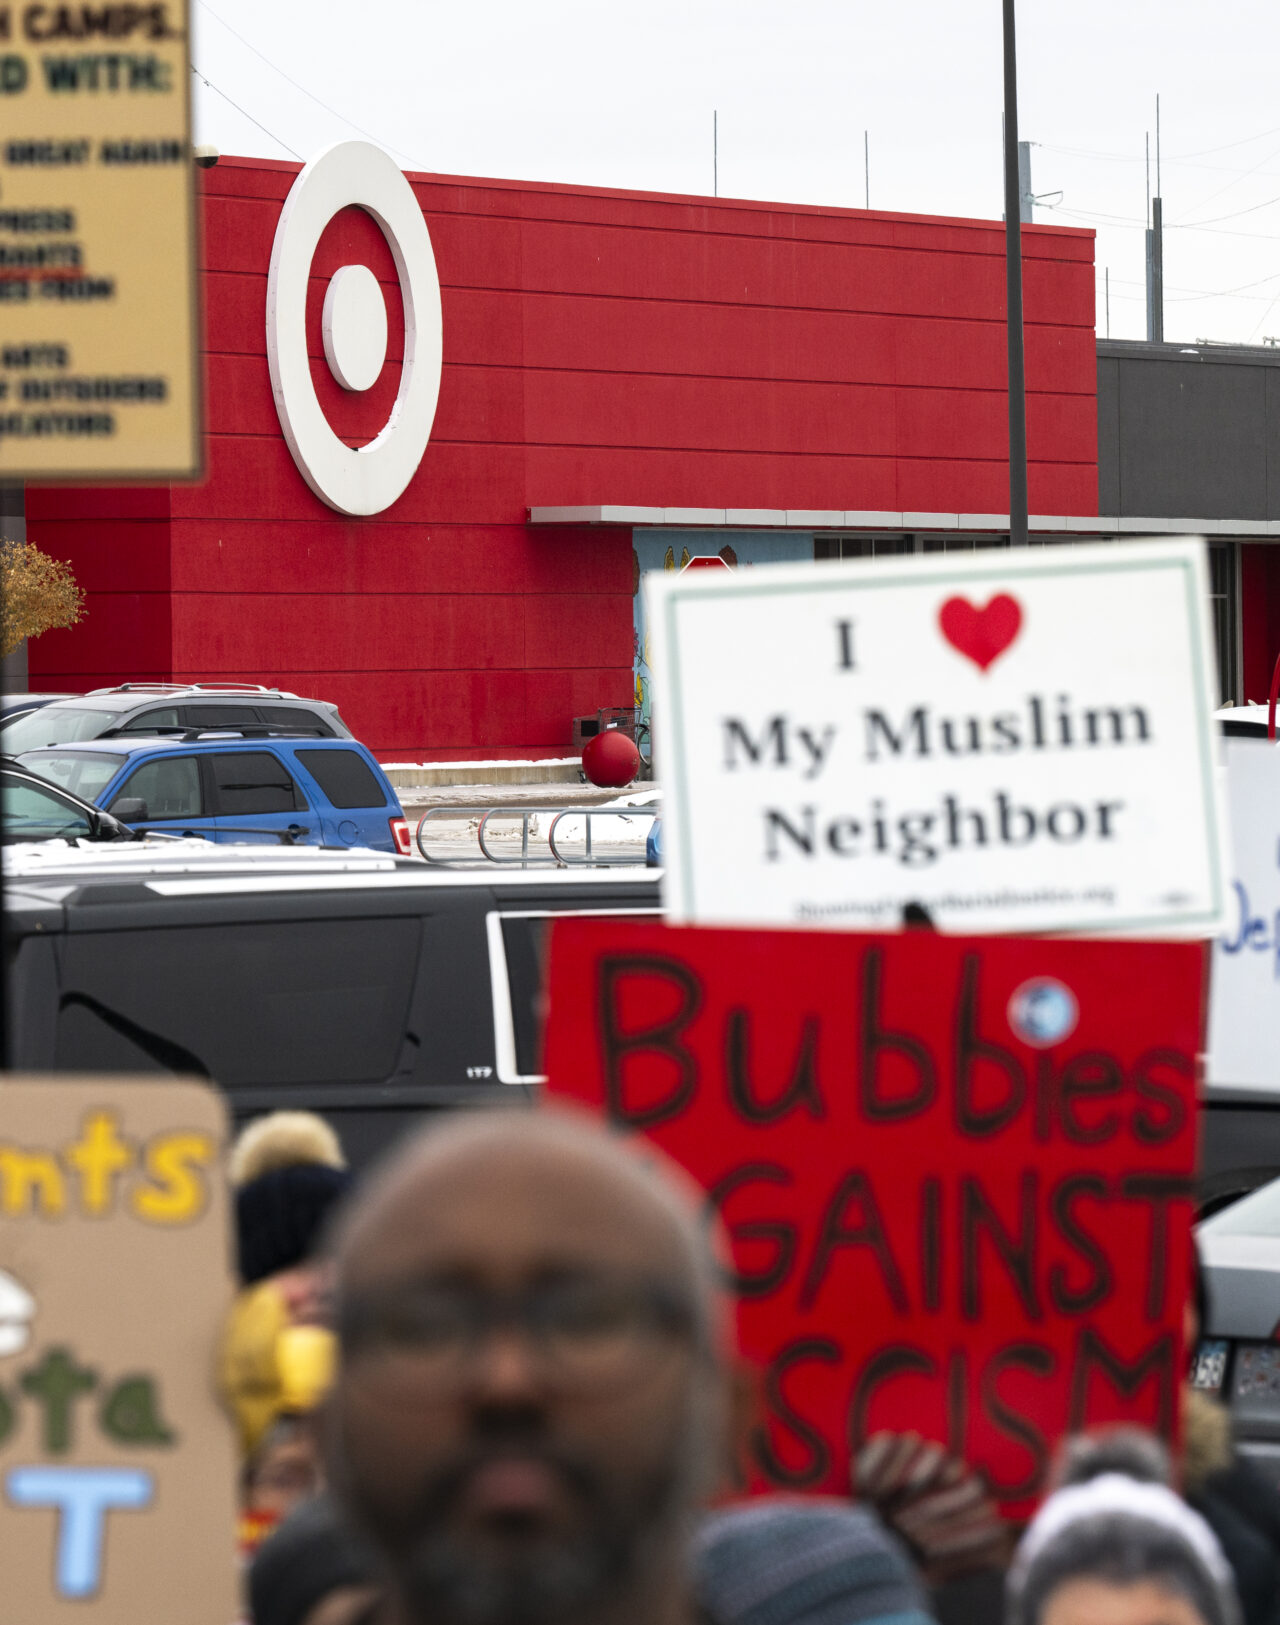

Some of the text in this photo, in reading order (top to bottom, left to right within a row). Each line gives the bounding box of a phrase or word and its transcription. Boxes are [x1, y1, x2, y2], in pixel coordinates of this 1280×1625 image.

[25, 3, 184, 42] CAMPS.
[42, 51, 173, 94] WITH:
[5, 141, 89, 165] GREAT
[834, 617, 858, 672] I
[722, 694, 1151, 779] My Muslim
[764, 792, 1123, 865] Neighbor
[597, 946, 1192, 1145] Bubbies
[704, 1161, 1195, 1322] GAINST
[730, 1325, 1177, 1500] SCISM
